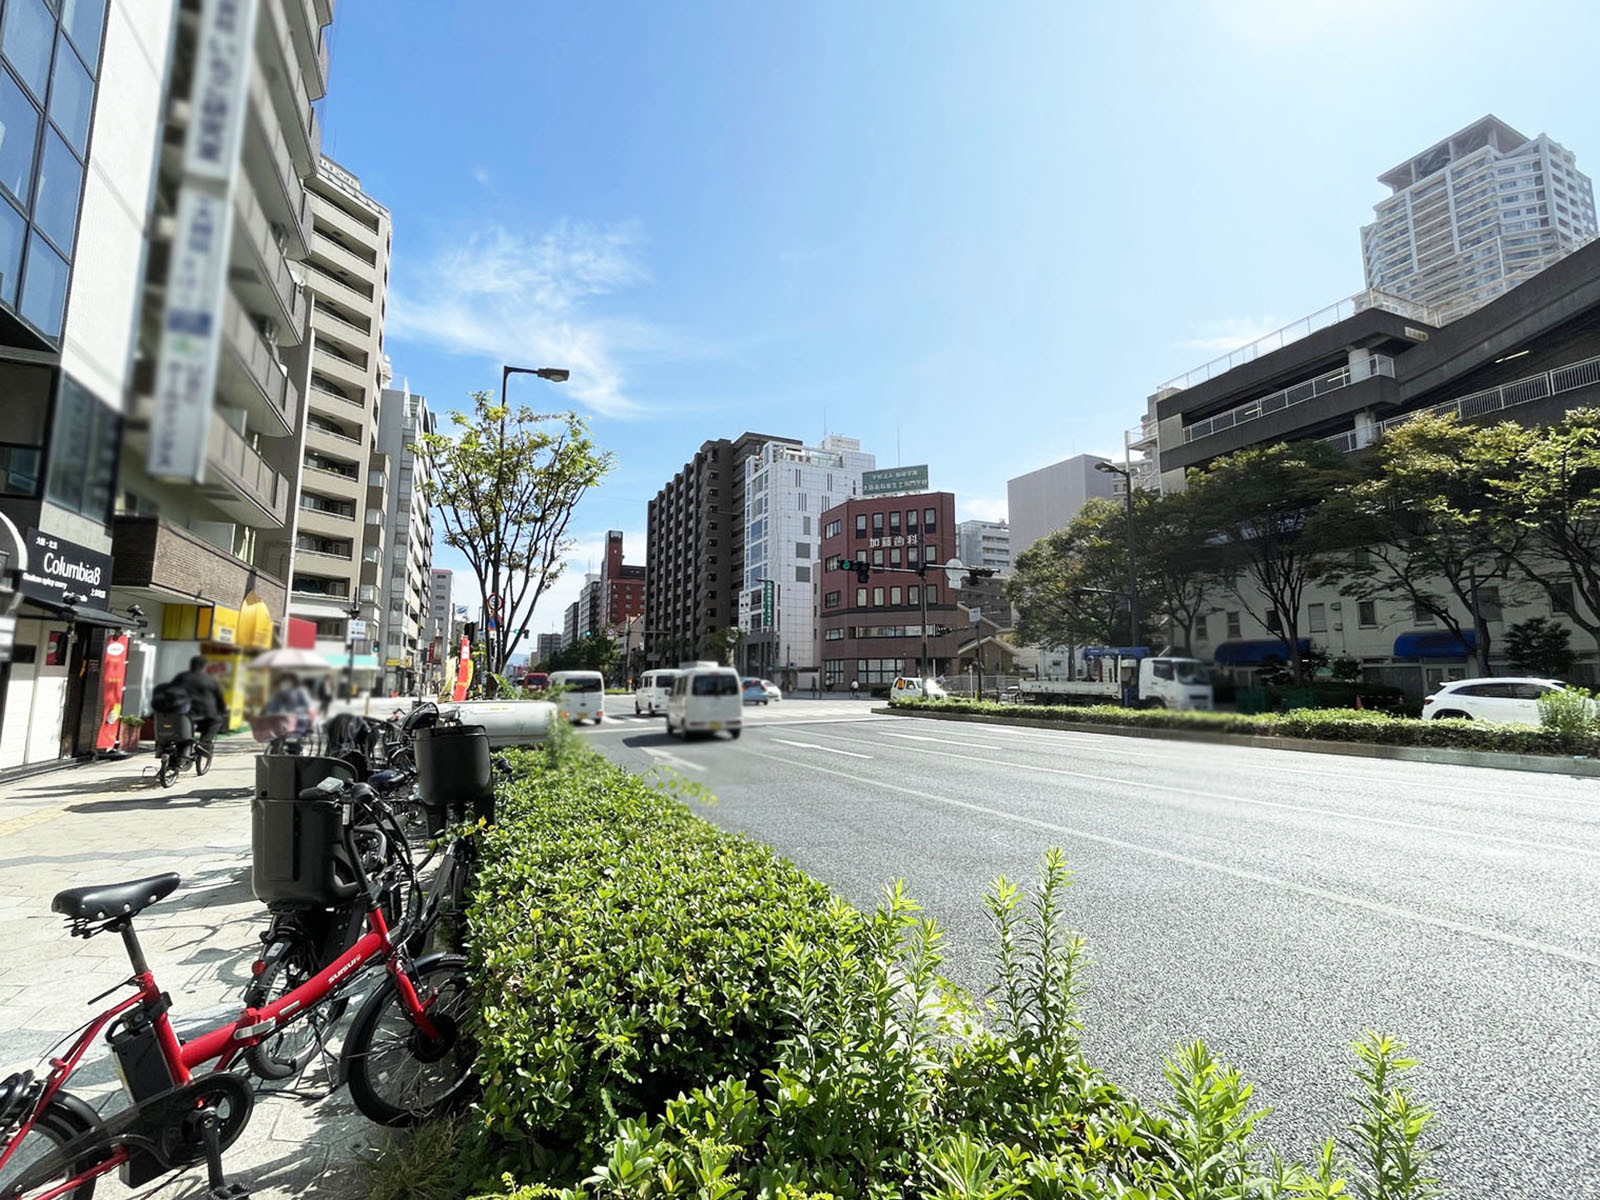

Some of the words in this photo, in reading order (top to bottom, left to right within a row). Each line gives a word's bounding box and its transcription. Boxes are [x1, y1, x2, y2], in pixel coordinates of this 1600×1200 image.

[869, 534, 918, 548] 加藤歯科
[43, 552, 101, 585] Columbia8
